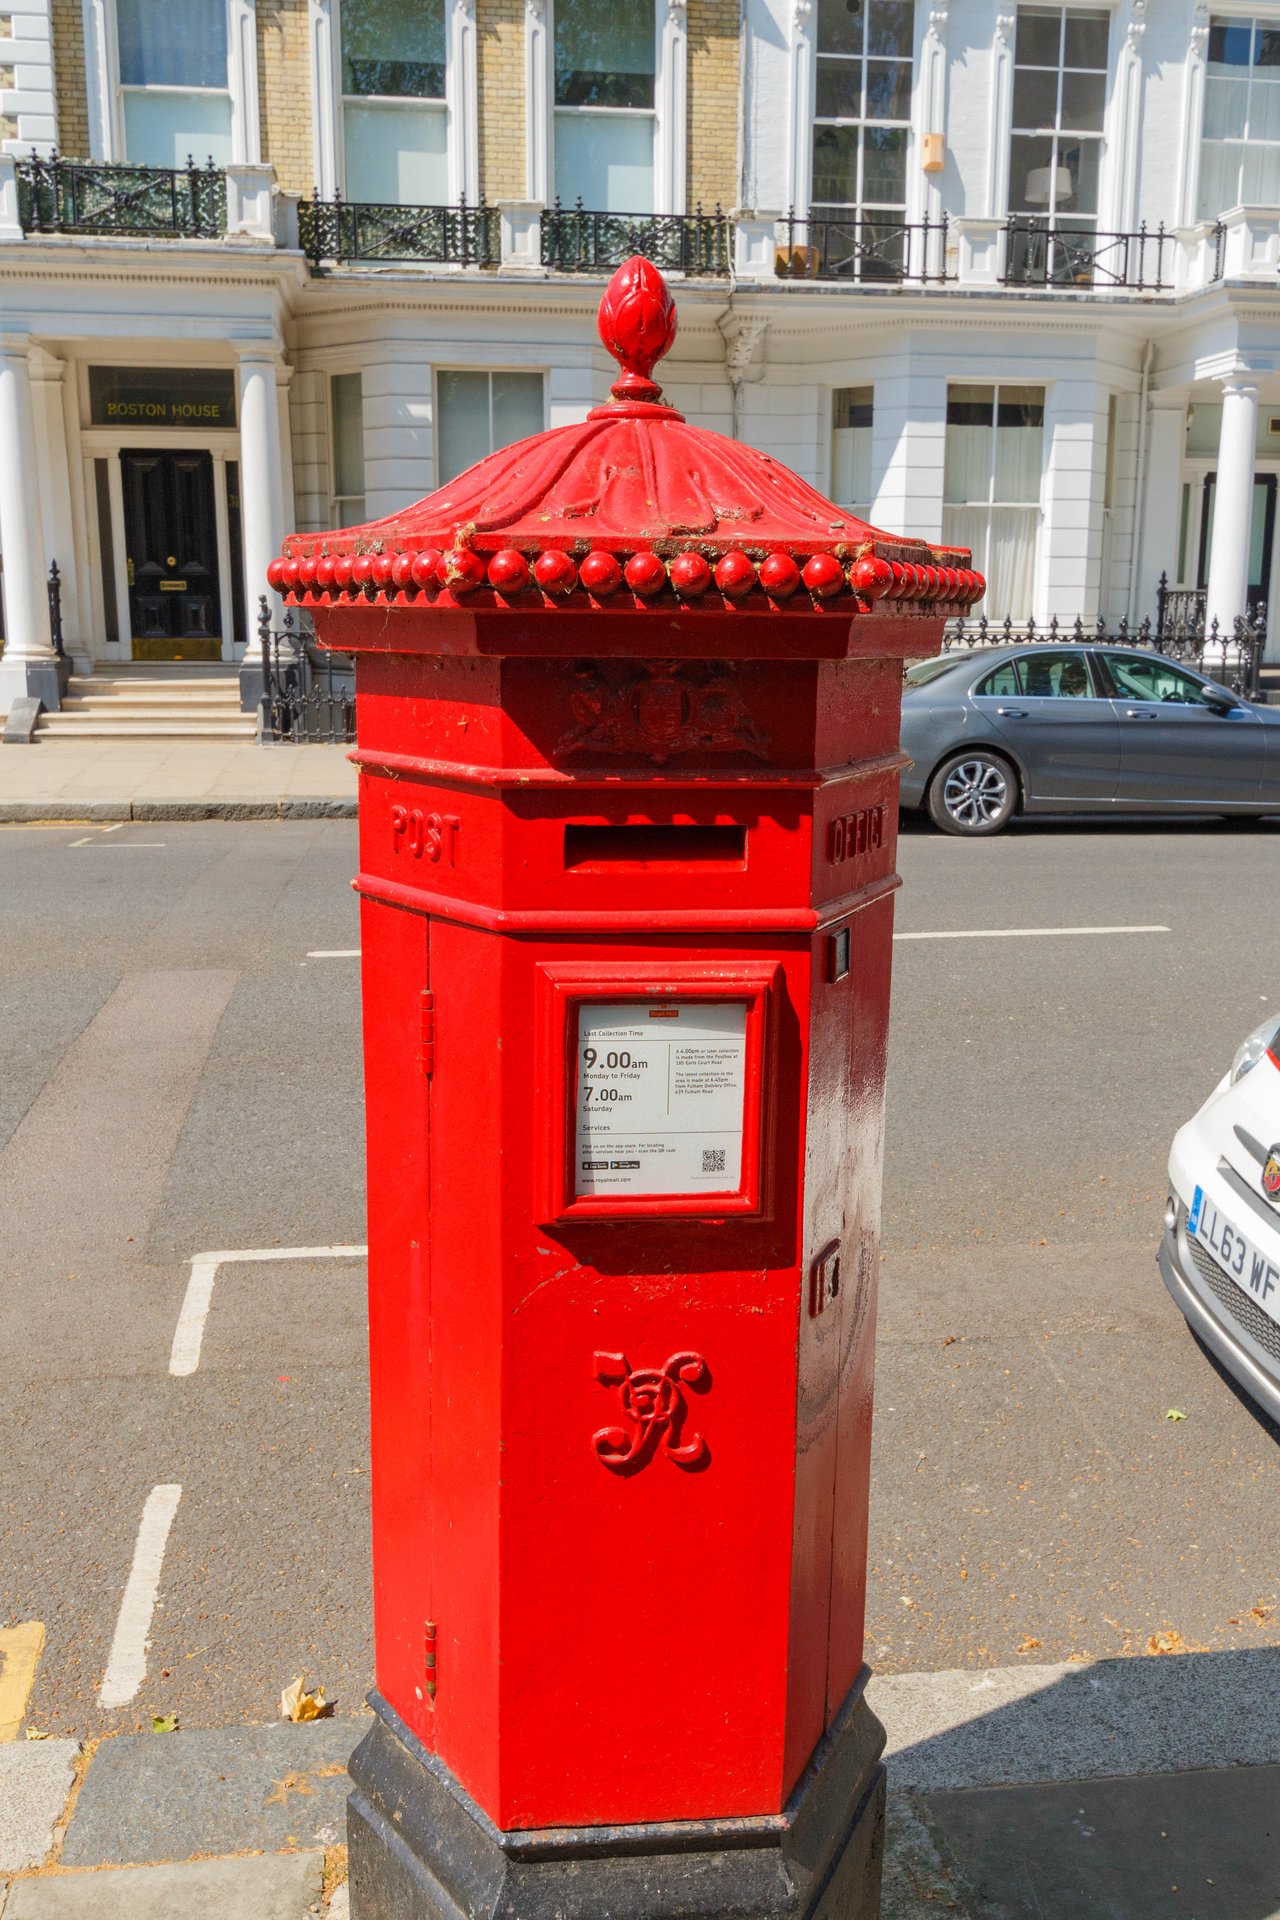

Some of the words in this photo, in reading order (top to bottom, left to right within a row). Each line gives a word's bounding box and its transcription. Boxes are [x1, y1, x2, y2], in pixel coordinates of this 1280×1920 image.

[108, 402, 166, 417] BOSTON
[172, 403, 221, 418] HOUSE
[391, 804, 461, 868] POST
[651, 1010, 666, 1018] Royal
[583, 1047, 648, 1069] 9.00am
[583, 1086, 633, 1102] 7.00am
[1200, 1200, 1246, 1276] LL63
